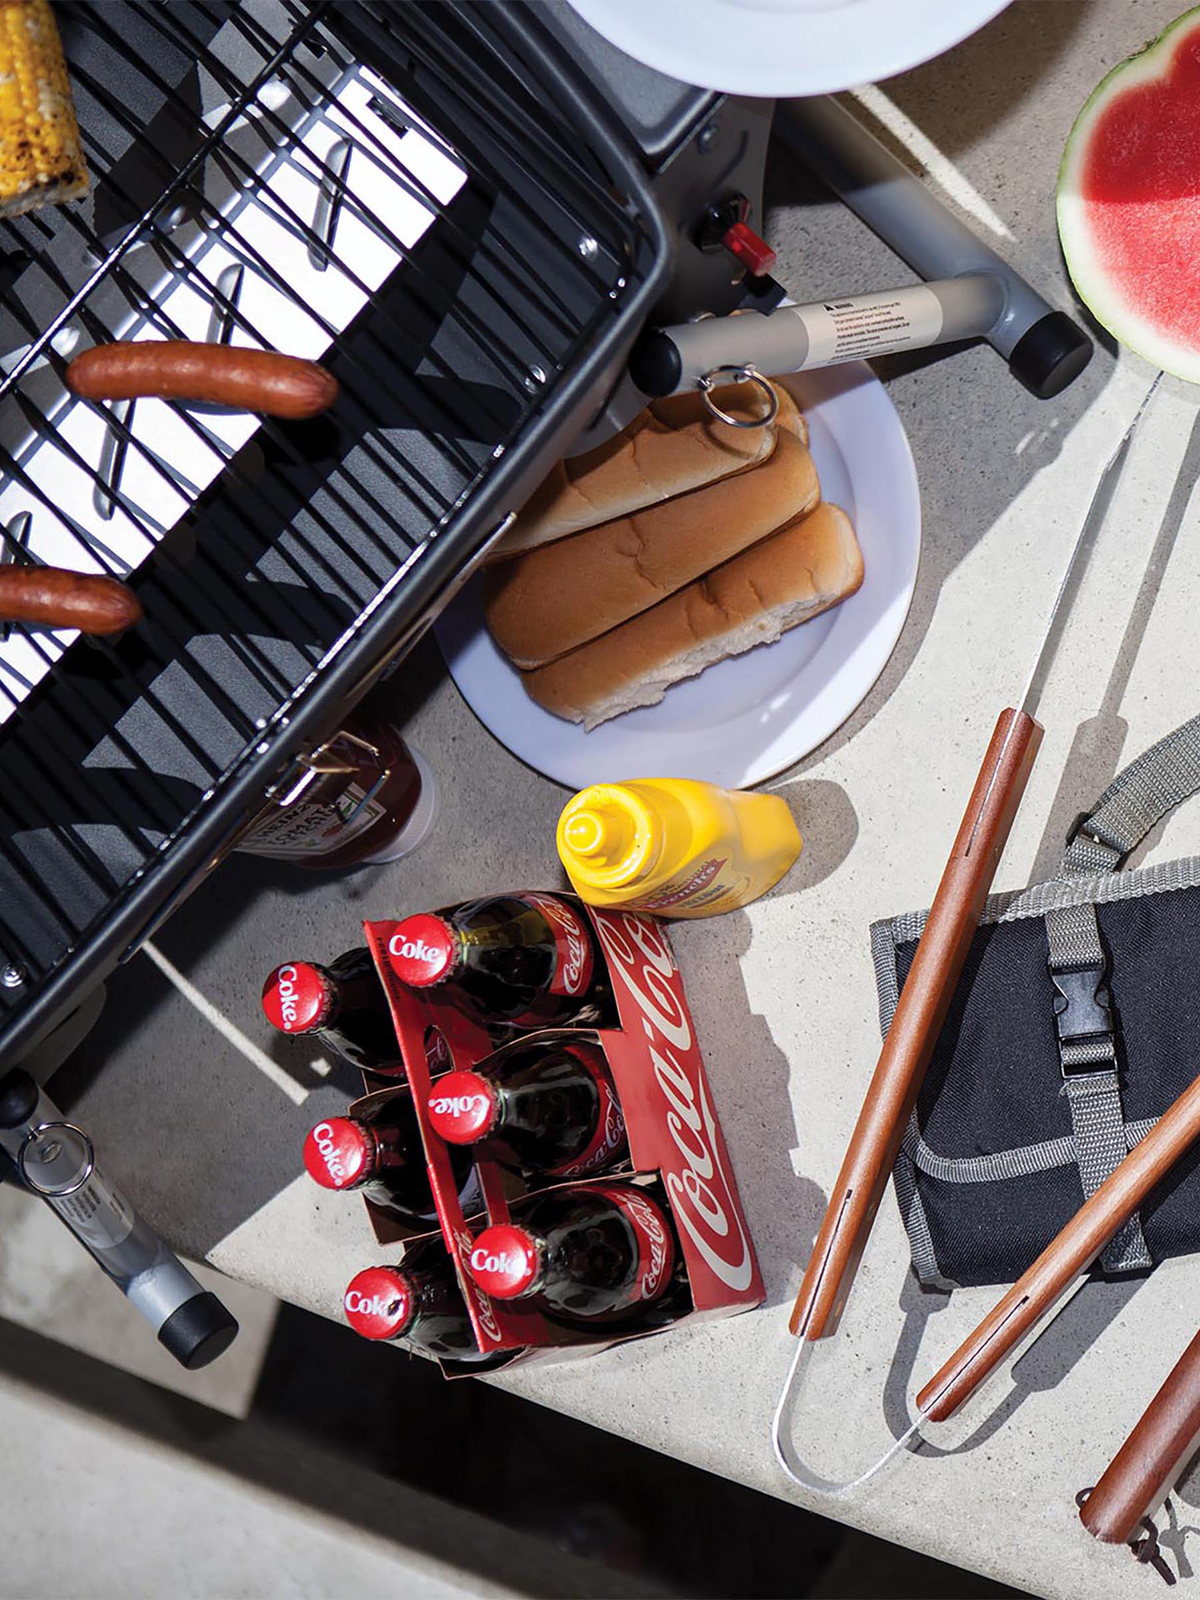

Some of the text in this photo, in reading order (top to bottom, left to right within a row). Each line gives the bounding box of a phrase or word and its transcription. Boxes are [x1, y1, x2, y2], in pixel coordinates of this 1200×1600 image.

[388, 934, 441, 963] Coke
[590, 904, 752, 1292] Coca-Co
[471, 1249, 532, 1277] Cok
[345, 1291, 401, 1320] Cok
